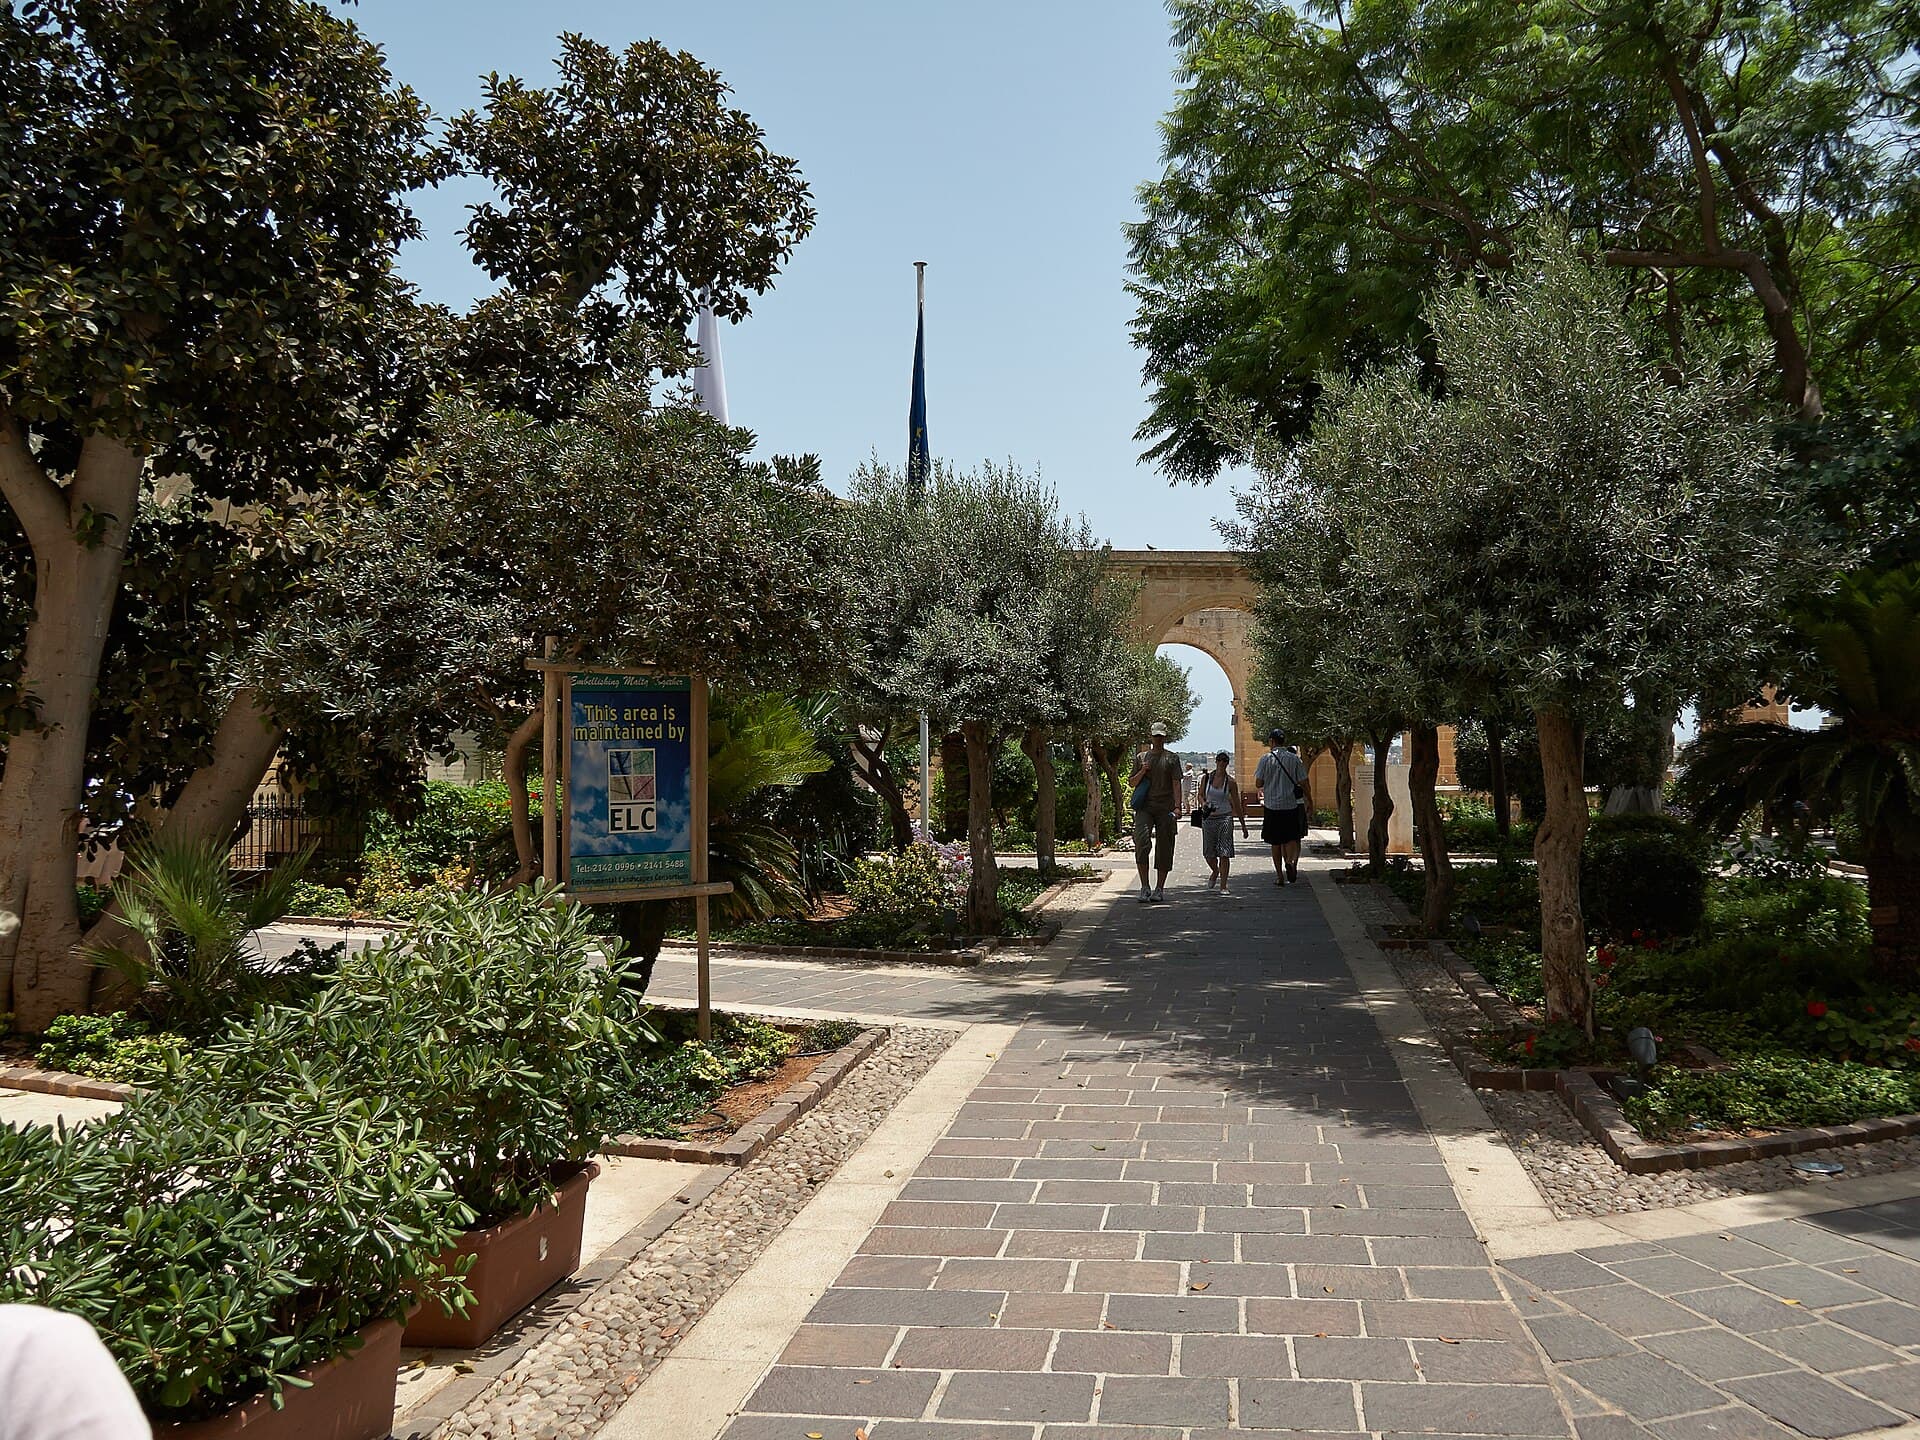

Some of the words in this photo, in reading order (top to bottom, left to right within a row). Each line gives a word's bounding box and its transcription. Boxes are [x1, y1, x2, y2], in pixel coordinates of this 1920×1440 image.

[570, 676, 619, 688] Embellishing
[653, 677, 683, 688] ogether
[584, 705, 617, 721] This
[624, 708, 657, 721] area
[663, 705, 675, 721] is
[575, 723, 662, 741] maintained
[668, 723, 686, 742] by
[610, 807, 655, 831] ELC
[576, 864, 590, 873] Tel:
[643, 860, 663, 870] 2141
